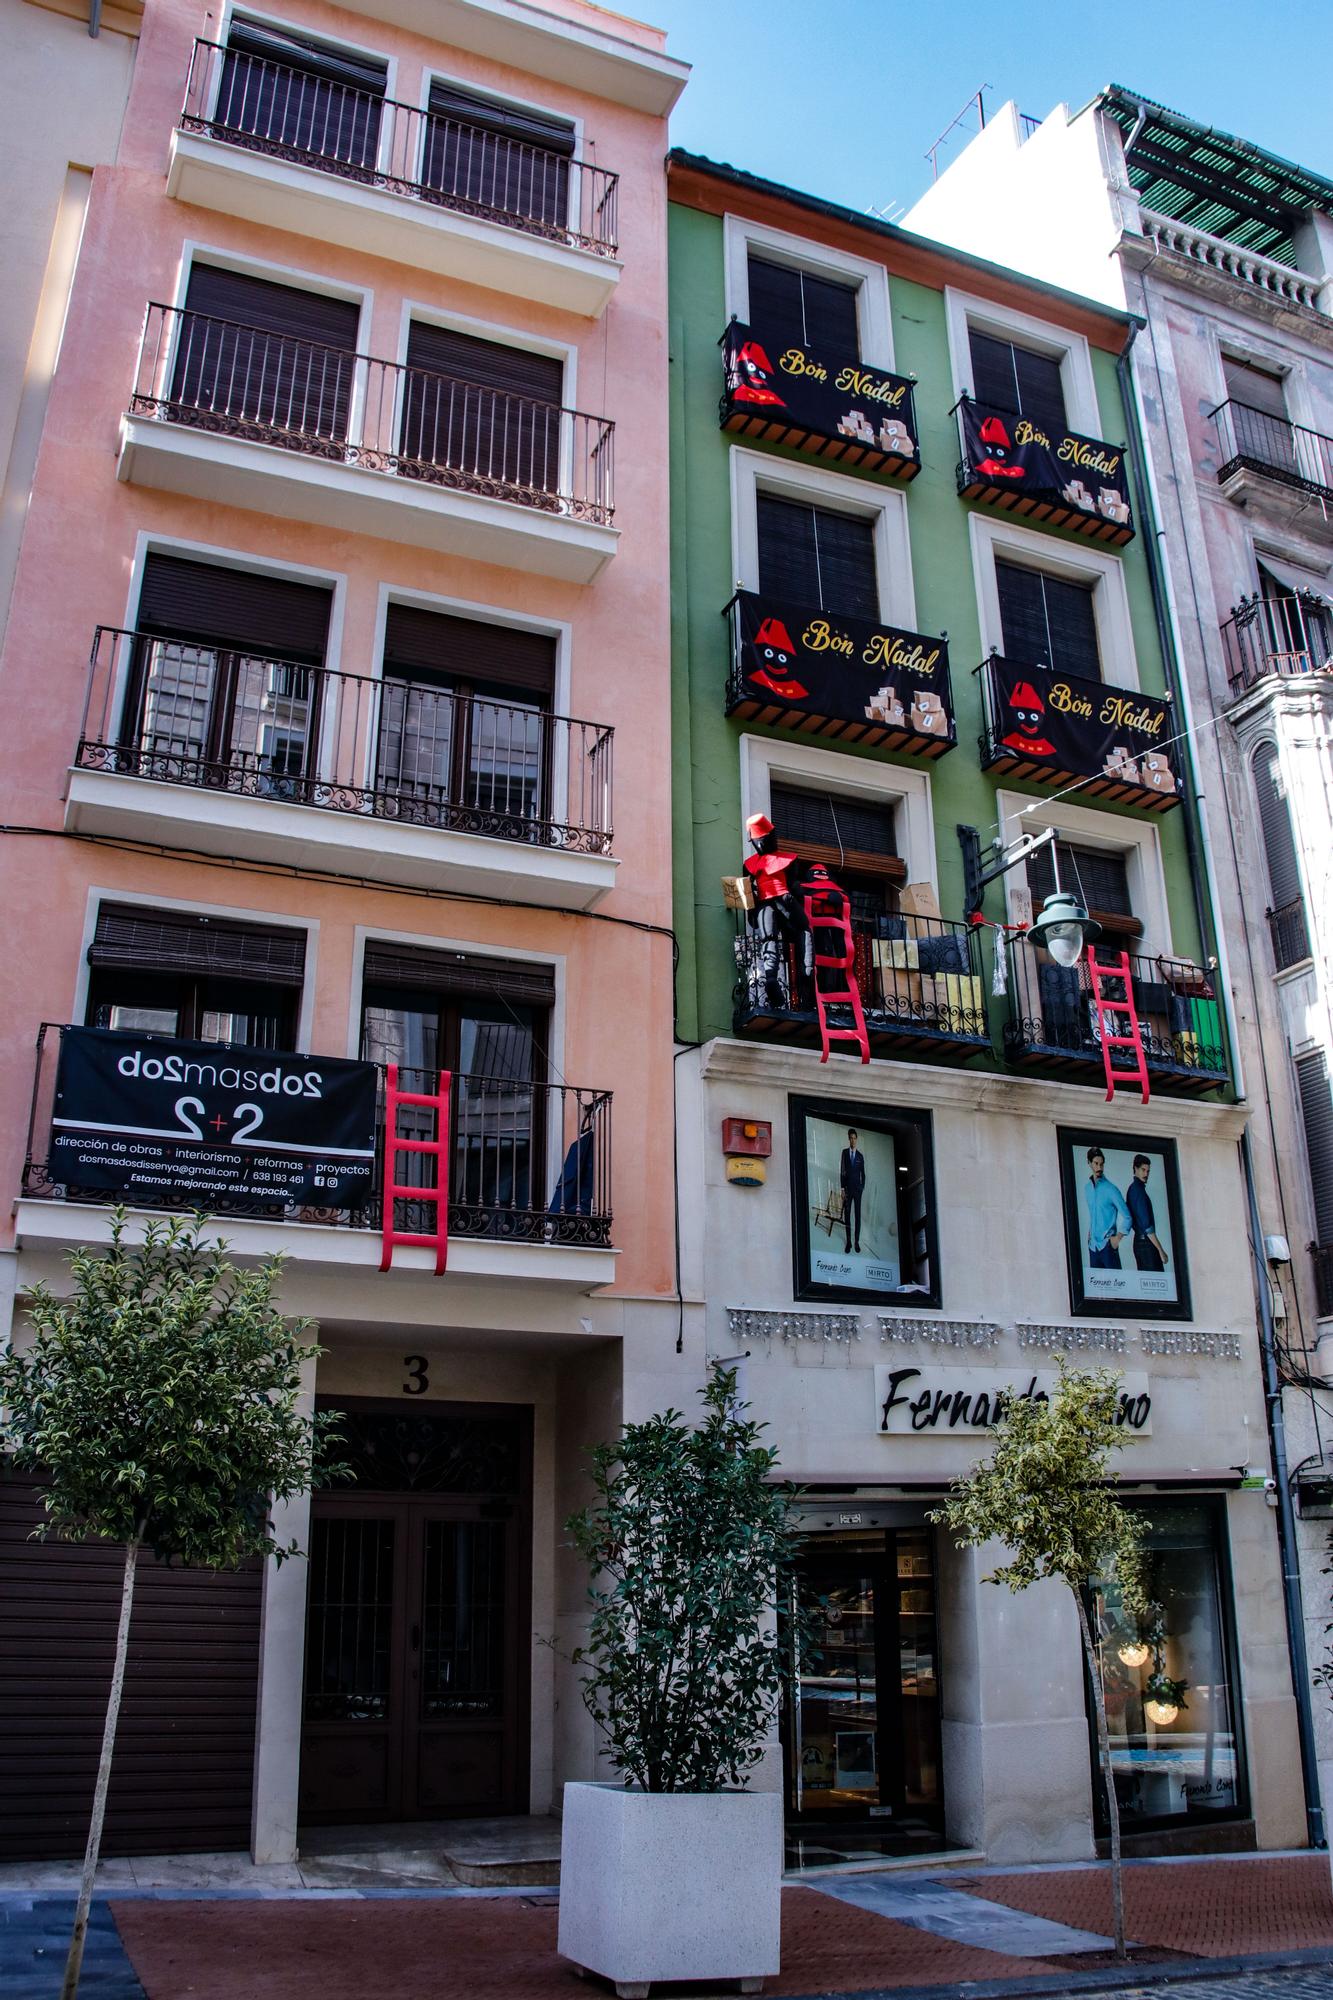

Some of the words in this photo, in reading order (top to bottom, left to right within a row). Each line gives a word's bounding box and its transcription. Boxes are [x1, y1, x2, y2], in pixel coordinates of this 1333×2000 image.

[780, 349, 828, 382] Bon
[835, 368, 906, 407] Nadal
[1015, 420, 1051, 449] Bon
[1058, 438, 1120, 475] Nadal
[802, 620, 854, 655] Bon
[862, 635, 940, 675] Nadal
[1049, 683, 1093, 717] Bon
[1100, 697, 1165, 735] Nadal
[55, 1136, 109, 1150] dirección
[112, 1142, 127, 1152] de
[130, 1144, 163, 1156] obras
[175, 1147, 241, 1164] interiorismo
[254, 1156, 304, 1170] reformas
[315, 1163, 371, 1176] proyectos
[78, 1154, 239, 1178] dosmasdosdissenya@gmail.com
[253, 1172, 270, 1182] 638
[272, 1173, 287, 1183] 193
[289, 1175, 304, 1184] 461
[131, 1173, 172, 1186] Estamos
[174, 1178, 227, 1191] mejorando
[228, 1182, 249, 1193] este
[867, 1269, 890, 1279] MIRTO
[1142, 1281, 1166, 1289] MIRTO
[402, 1355, 429, 1395] 3
